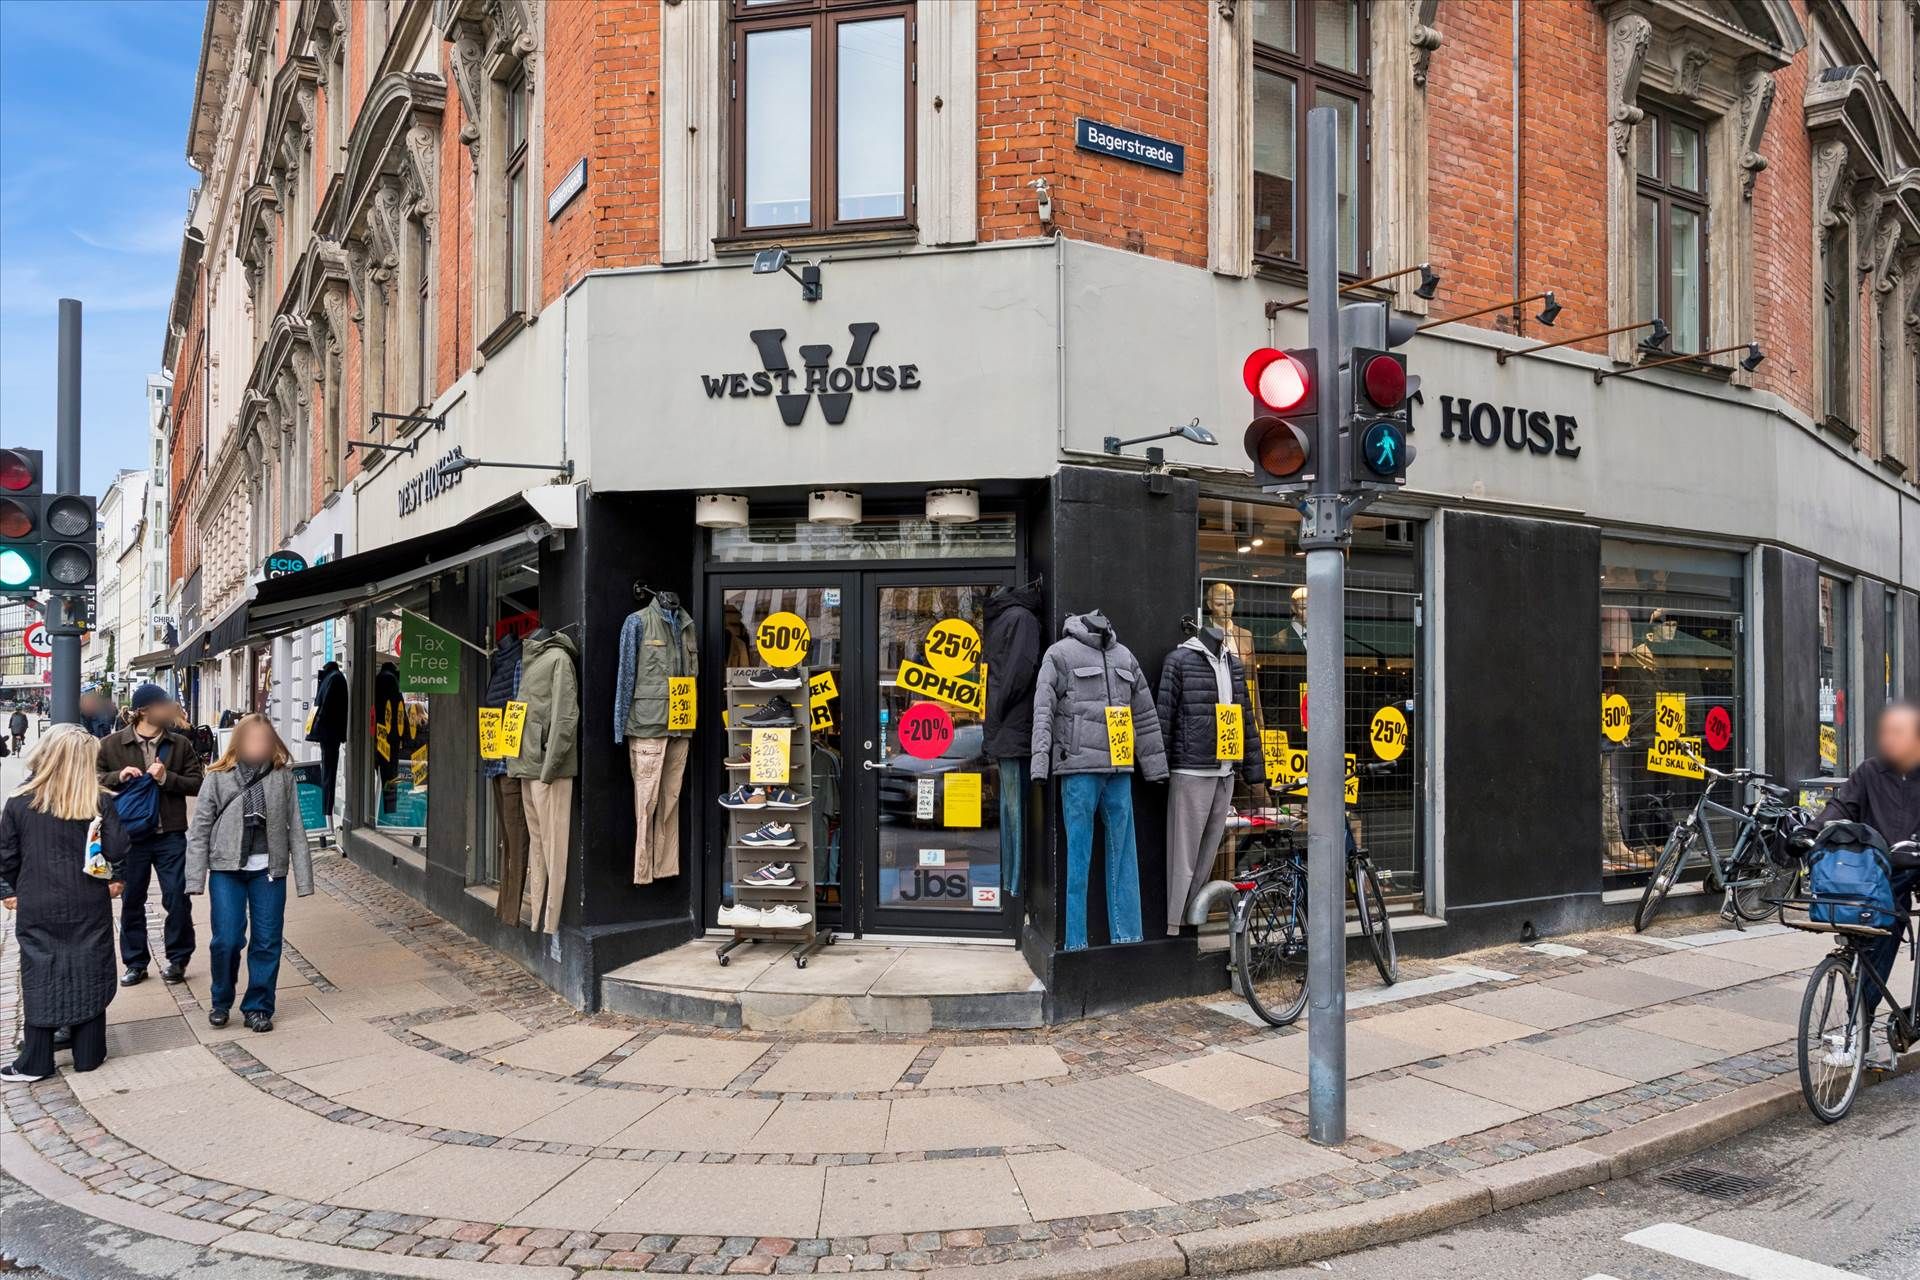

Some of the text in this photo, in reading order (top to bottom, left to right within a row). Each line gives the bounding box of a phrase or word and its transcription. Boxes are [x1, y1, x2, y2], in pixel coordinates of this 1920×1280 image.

[1088, 127, 1174, 163] Bagerstræde
[701, 364, 922, 399] WEST HOUSE
[1439, 395, 1582, 459] HOUSE
[415, 634, 445, 651] Tax
[757, 625, 811, 652] -50%
[925, 630, 982, 663] -25%
[410, 653, 449, 669] Free
[734, 669, 759, 677] JACK
[410, 675, 448, 685] planet
[810, 680, 832, 697] ÆK
[1602, 706, 1631, 727] -50%
[1657, 705, 1683, 733] -25%
[904, 718, 949, 741] -20%
[1371, 719, 1407, 746] -25%
[1650, 756, 1664, 766] ALT
[1665, 758, 1685, 770] SKAL
[900, 869, 967, 900] jbs
